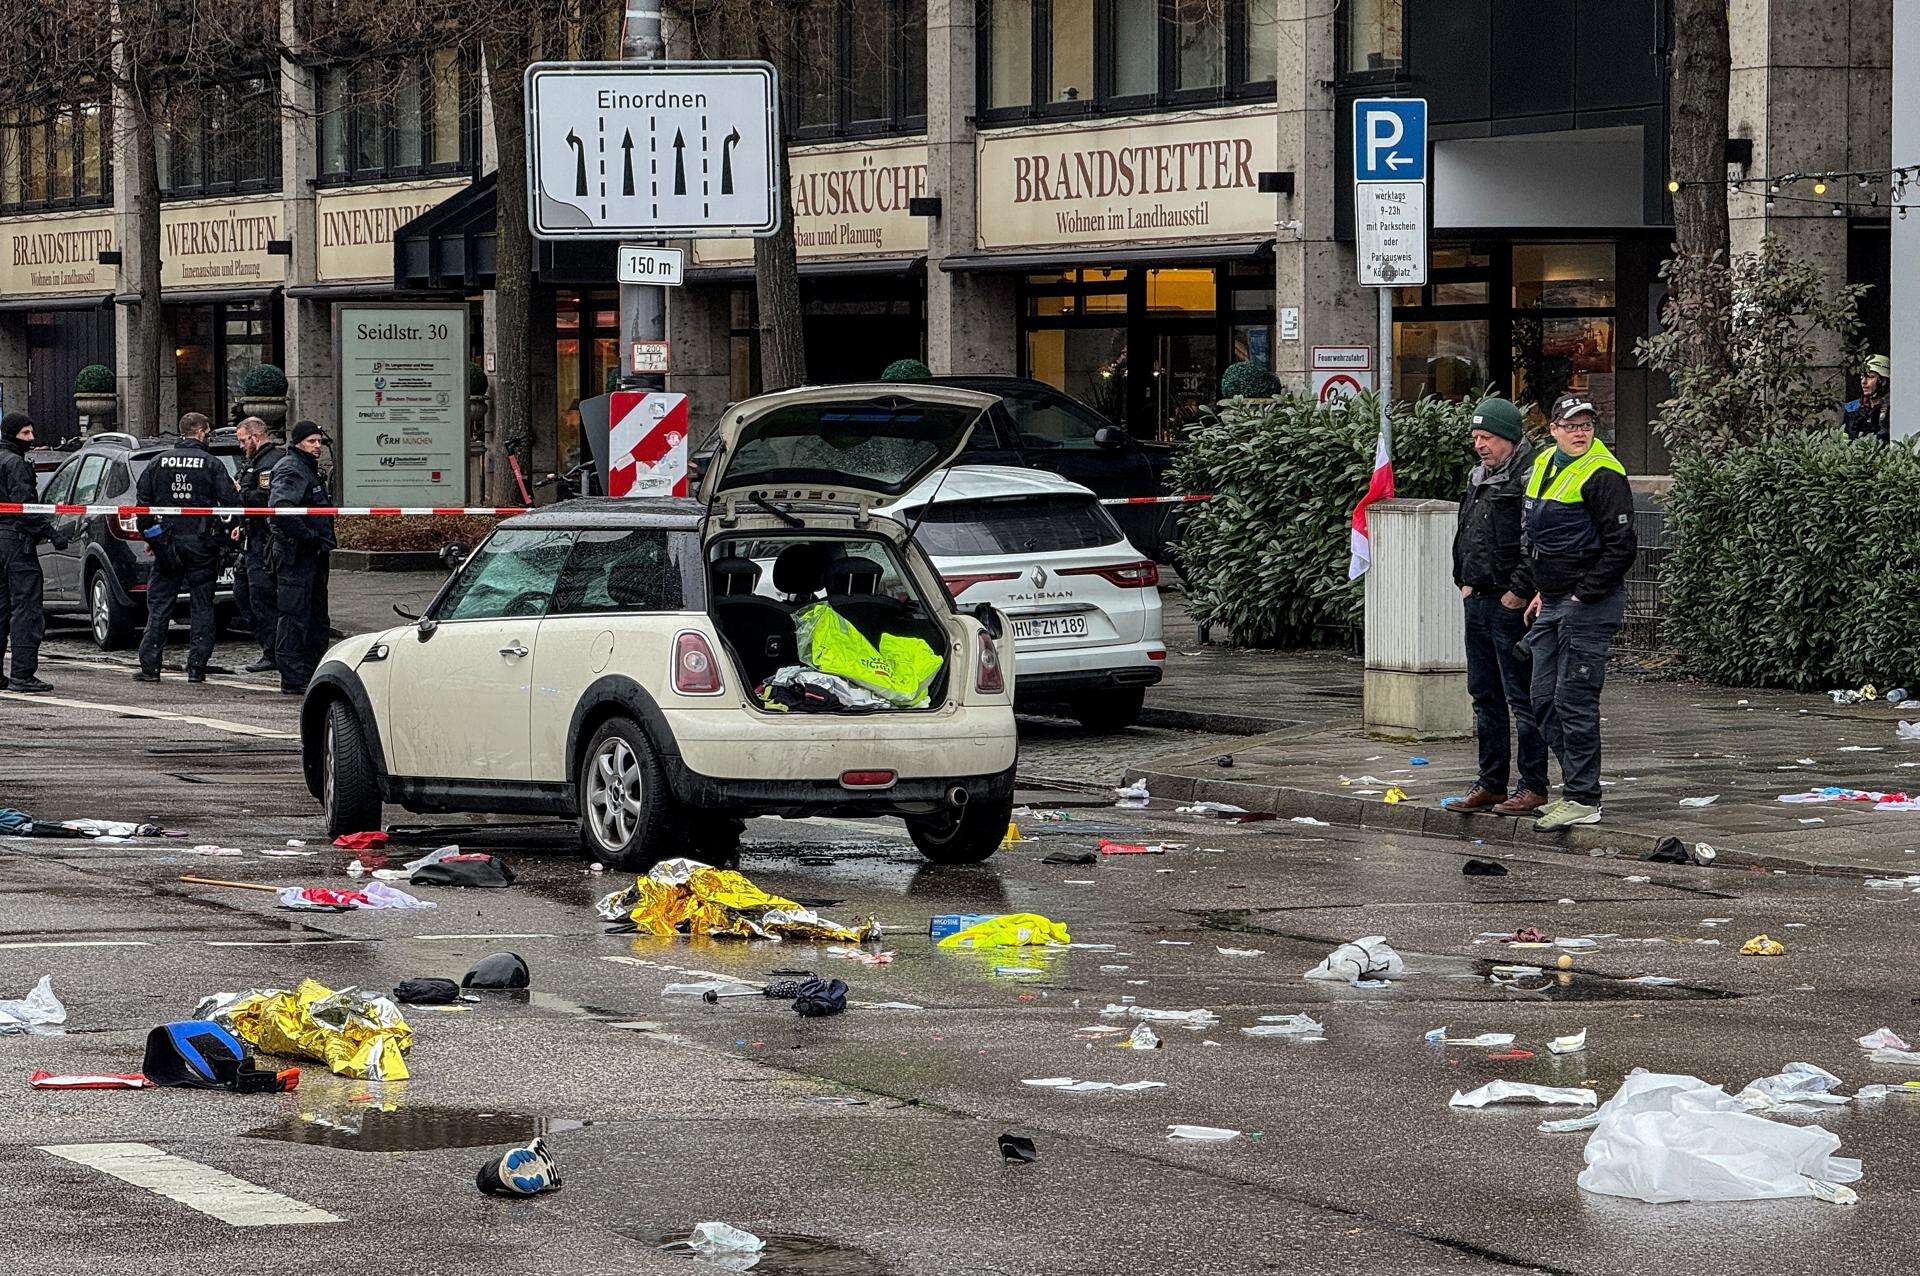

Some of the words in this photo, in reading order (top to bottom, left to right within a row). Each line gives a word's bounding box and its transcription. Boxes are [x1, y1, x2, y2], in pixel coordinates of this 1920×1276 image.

[598, 90, 707, 109] Einordnen
[1366, 110, 1404, 171] P
[1013, 137, 1256, 203] BRANDSTETTER
[1374, 189, 1406, 200] werktags
[1055, 209, 1105, 234] Wohnen
[1108, 206, 1124, 229] im
[1127, 201, 1210, 229] Landhausstil
[1380, 206, 1401, 215] 9-23h
[166, 209, 278, 257] WERKSTÄTTEN
[1366, 222, 1377, 231] mit
[1379, 221, 1416, 231] Parkschein
[817, 223, 837, 246] und
[840, 222, 882, 248] Planung
[1383, 237, 1399, 246] oder
[12, 228, 113, 266] BRANDSTETTER
[1371, 252, 1412, 262] Parkausweis
[182, 261, 221, 279] Innenausbau
[221, 260, 234, 278] und
[235, 259, 260, 278] Planung
[631, 256, 654, 275] 150
[659, 262, 671, 276] m
[31, 271, 52, 287] Wohnen
[52, 270, 60, 286] im
[61, 268, 95, 285] Landhausstil
[357, 323, 422, 340] Seidlstr.
[428, 323, 448, 340] 30
[636, 345, 642, 353] H
[1317, 353, 1365, 362] Feuerwehrzufahrt
[384, 437, 401, 445] SRH
[161, 456, 205, 468] POLIZEI
[175, 473, 187, 483] BY
[171, 482, 193, 492] 6240
[1008, 590, 1073, 600] TALISMAN
[1041, 619, 1060, 636] ZM
[1060, 618, 1085, 634] 189
